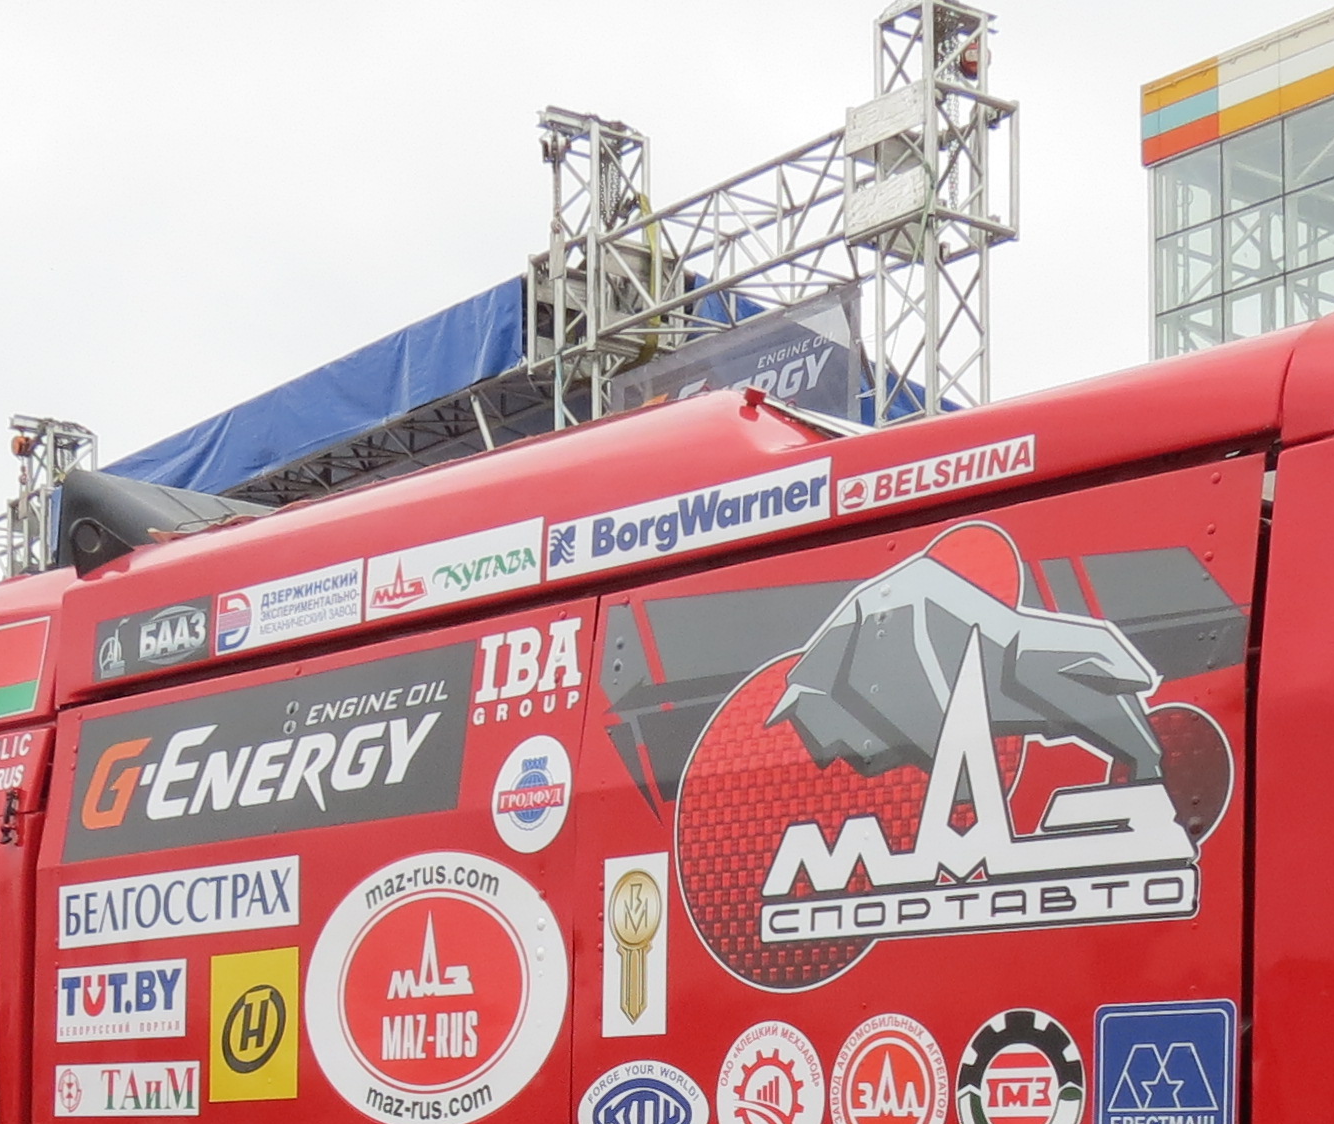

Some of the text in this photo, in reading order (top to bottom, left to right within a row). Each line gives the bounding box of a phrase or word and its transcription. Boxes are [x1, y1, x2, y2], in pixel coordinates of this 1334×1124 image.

[757, 338, 811, 369] ENGINE
[873, 441, 1031, 502] BELSHINA
[592, 474, 828, 558] BorgWarner
[261, 568, 359, 608] ДЗЕРЖИНСКИЙ
[432, 547, 537, 592] КУПАВА
[260, 588, 360, 622] ЭКСПЕРИМЕНТАЛЬНО-
[260, 603, 358, 635] МЕХАНИЧЕСКИЙ ЗАВОД
[139, 609, 206, 659] БААЗ
[475, 617, 582, 704] IBA
[305, 680, 449, 727] ENGINE OIL
[472, 691, 580, 725] GROUP
[499, 785, 563, 810] ГРОДФУД
[65, 867, 291, 936] БЕЛГОССТРАХ
[365, 864, 500, 910] maz-rus.com
[768, 876, 1184, 935] СПОРТАВТО
[61, 967, 182, 1018] TUT.BY
[60, 1020, 180, 1037] БЕЛОРУССКИЙ ПОРТАЛ
[381, 1010, 478, 1062] MAZ-RUS
[587, 1065, 700, 1105] FORGE YOUR WORLD!
[720, 1060, 735, 1087] ОАО
[831, 1015, 947, 1124] ЗАВОД АВТОМОБИЛЬНЫХ АГРЕГАТОВ
[365, 1083, 493, 1120] maz-rus.com
